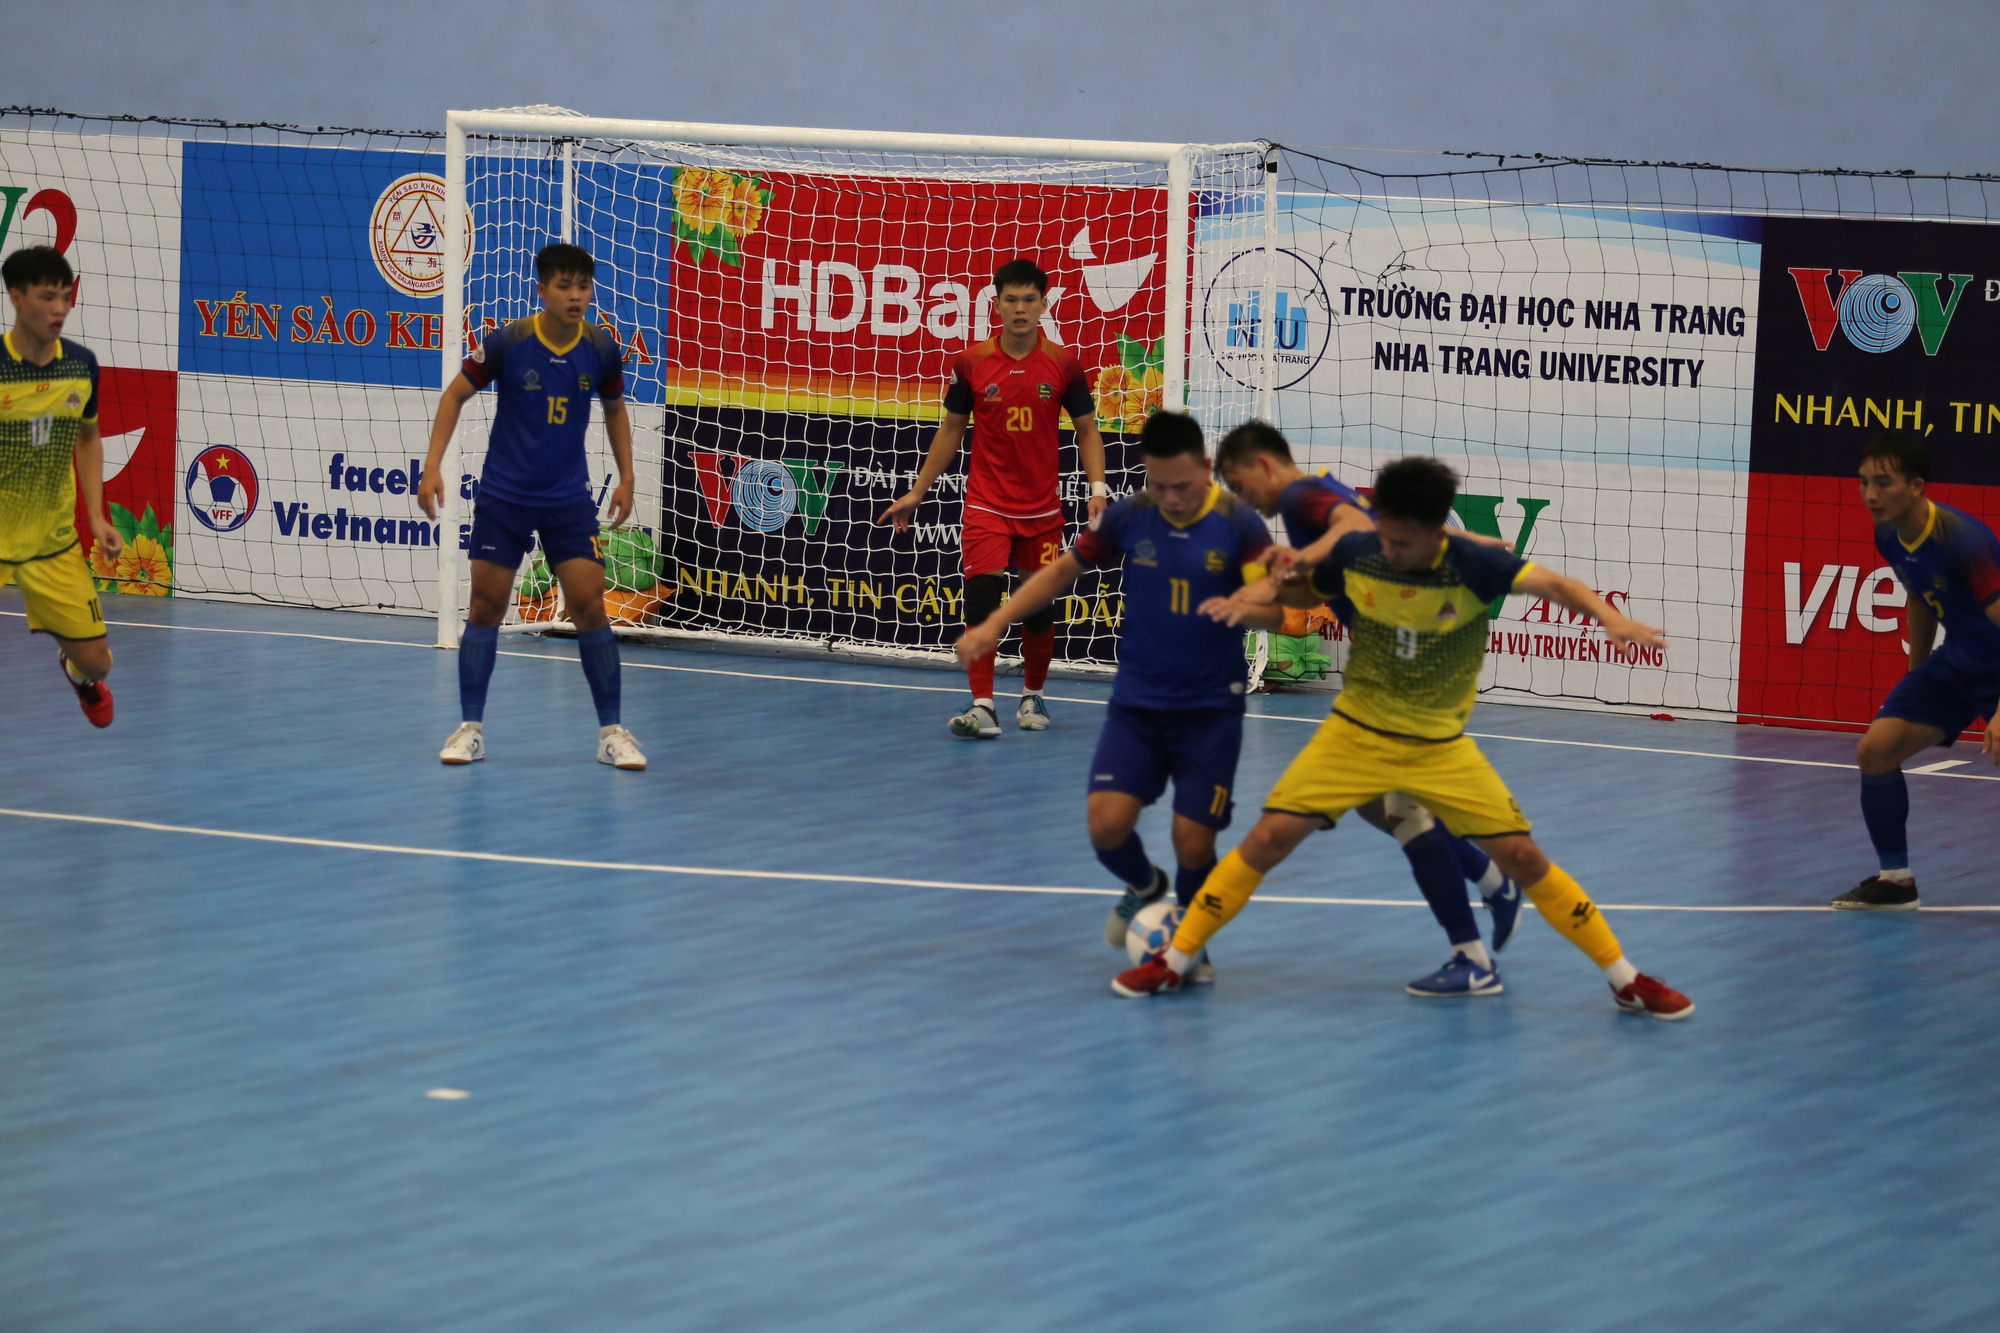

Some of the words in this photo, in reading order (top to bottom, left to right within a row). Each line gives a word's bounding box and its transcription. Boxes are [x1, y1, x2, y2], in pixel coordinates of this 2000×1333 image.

[194, 291, 282, 341] YẾN
[291, 296, 376, 347] SÀO
[1340, 282, 1450, 322] TRƯỜNG
[1459, 293, 1507, 330] ĐẠI
[1517, 296, 1575, 333] HỌC
[1584, 299, 1641, 332] NHA
[1651, 303, 1745, 337] TRANG
[1788, 267, 1974, 356] VOV
[1374, 341, 1429, 373] NHA
[1439, 345, 1530, 379] TRANG
[1540, 351, 1705, 389] UNIVERSITY
[547, 396, 569, 425] 15
[1006, 406, 1033, 432] 20
[1775, 393, 1934, 438] NHANH,
[211, 509, 233, 521] VFF
[827, 578, 883, 611] TIN
[896, 577, 966, 622] CẬY
[1169, 577, 1190, 615] 11
[1507, 632, 1530, 663] VỤ
